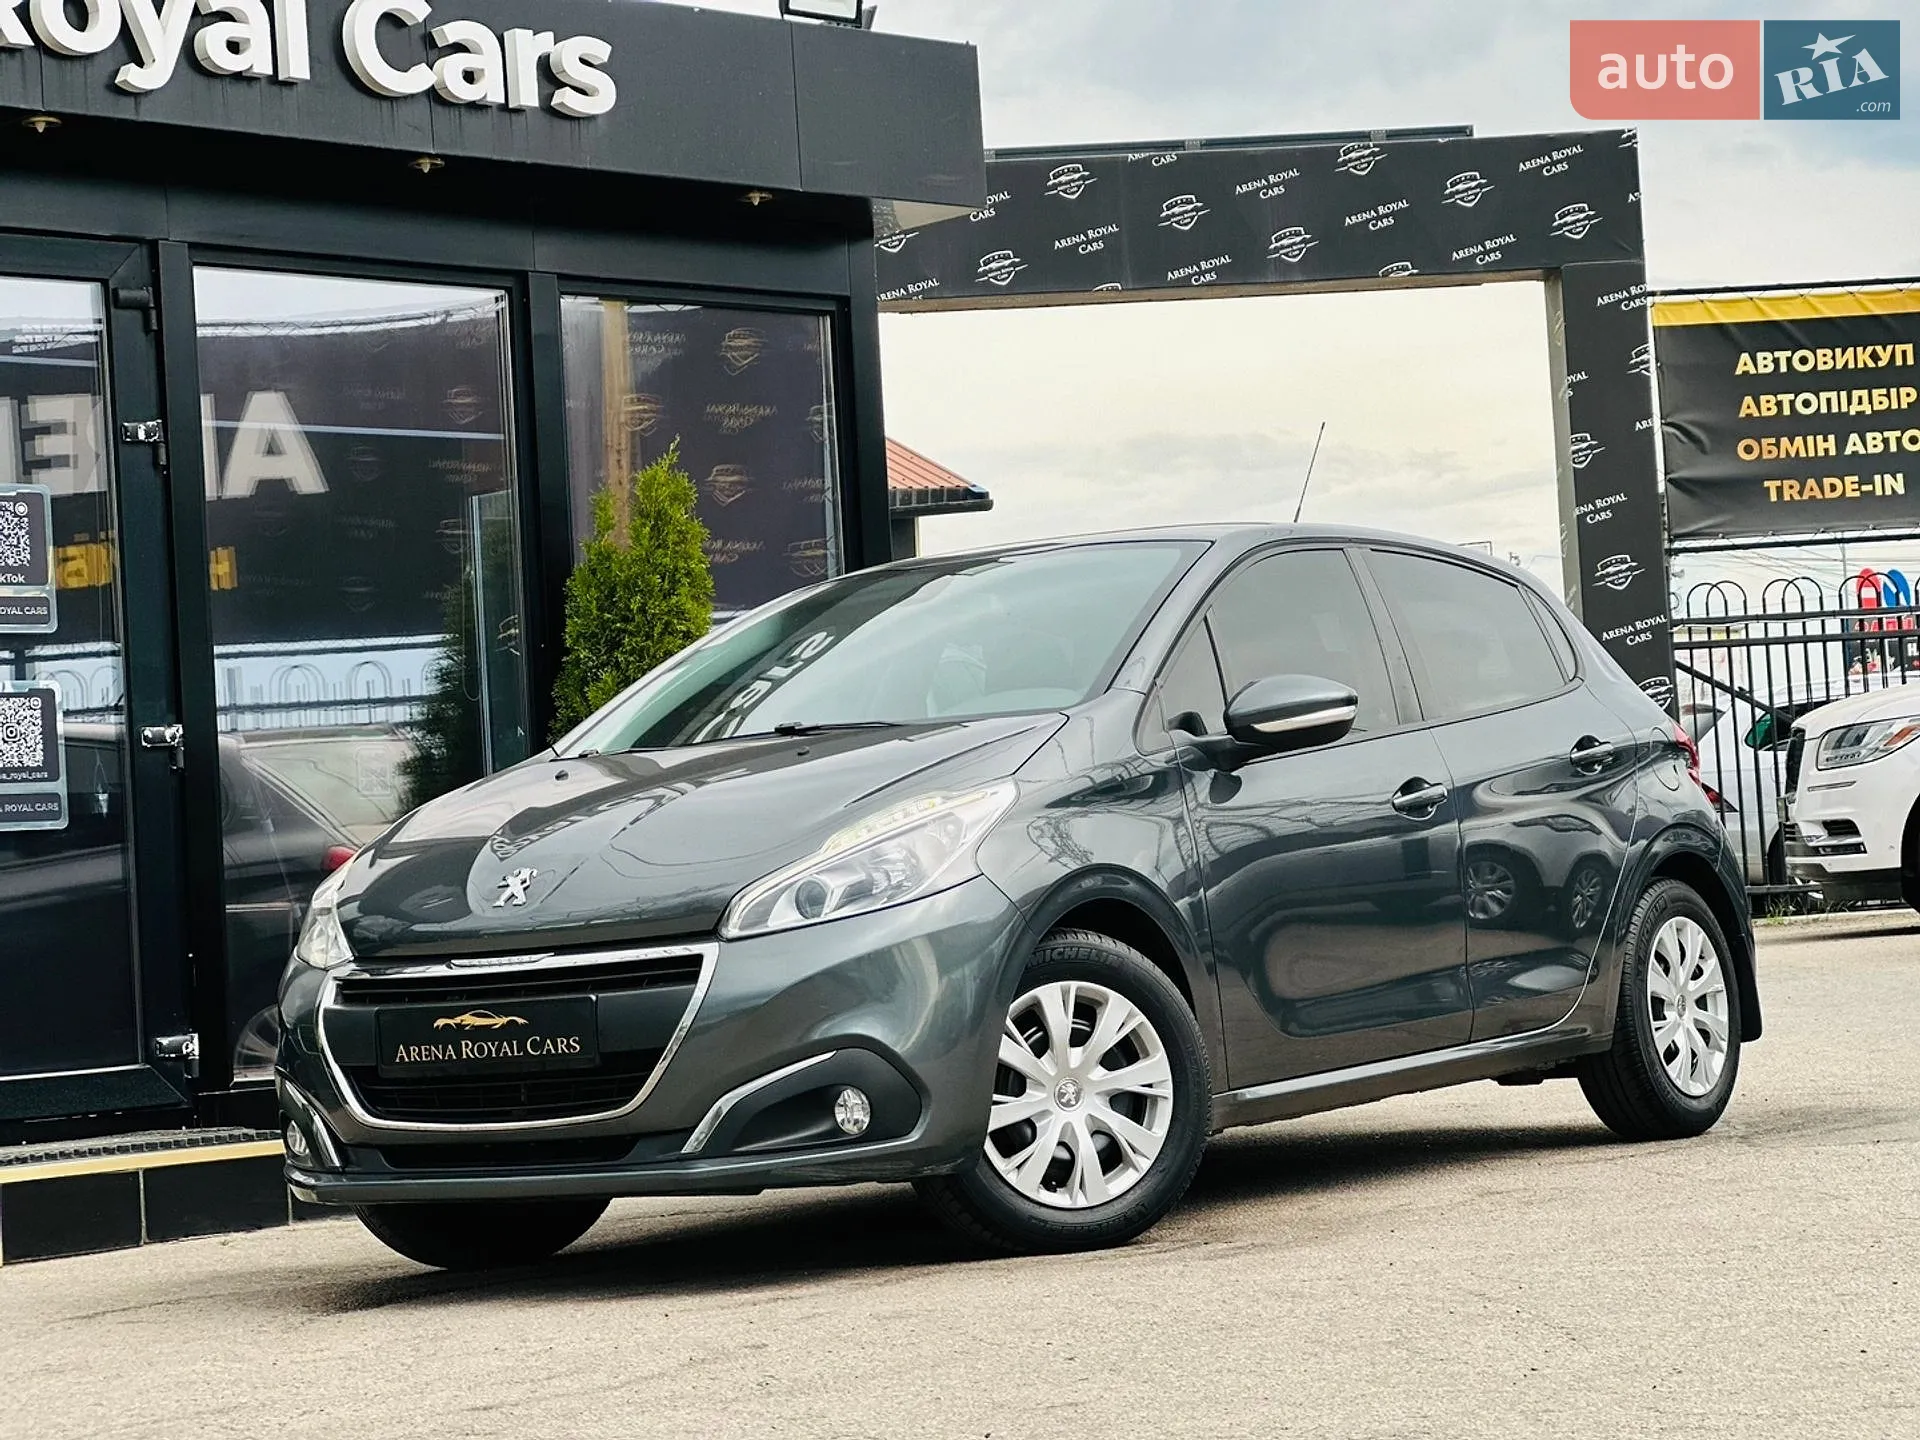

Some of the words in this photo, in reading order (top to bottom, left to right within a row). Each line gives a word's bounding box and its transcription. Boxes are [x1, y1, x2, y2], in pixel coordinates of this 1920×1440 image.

[0, 0, 310, 92] oyal
[342, 0, 617, 117] Cars
[1152, 153, 1177, 167] CARS
[1518, 155, 1551, 172] ARENA
[1551, 144, 1584, 161] ROYAL
[1542, 161, 1569, 176] CARS
[1235, 178, 1267, 195] ARENA
[1267, 168, 1300, 184] ROYAL
[986, 191, 1011, 205] OYAL
[1259, 184, 1285, 199] CARS
[969, 207, 995, 222] CARS
[1344, 210, 1377, 226] ARENA
[1377, 199, 1410, 216] ROYAL
[1368, 216, 1395, 231] CARS
[1054, 233, 1087, 250] ARENA
[1087, 223, 1120, 239] ROYAL
[1078, 240, 1104, 254] CARS
[1452, 244, 1484, 261] ARENA
[1484, 234, 1517, 250] ROYAL
[1475, 251, 1502, 265] CARS
[1167, 265, 1199, 281] ARENA
[1199, 254, 1232, 270] ROYAL
[907, 278, 940, 293] ROYAL
[1191, 271, 1217, 285] CARS
[1597, 290, 1630, 306] ARENA
[1621, 296, 1647, 310] CARS
[1735, 343, 1915, 375] АВТОВИКУП
[1565, 371, 1589, 385] OYAL
[1738, 386, 1918, 418] АВТОПІДБІР
[1737, 434, 1837, 461] ОБМІН
[1844, 428, 1920, 455] АВТО
[1764, 473, 1906, 502] TRADE-IN
[1574, 503, 1595, 515] ENA
[1595, 493, 1628, 508] ROYAL
[1586, 509, 1612, 524] CARS
[24, 606, 48, 615] CARS
[1602, 625, 1634, 641] ARENA
[1634, 614, 1668, 631] ROYAL
[1626, 631, 1652, 646] CARS
[4, 803, 34, 812] ROYAL
[395, 1043, 457, 1063] ARENA
[460, 1039, 523, 1059] ROYAL
[526, 1036, 580, 1056] CARS
